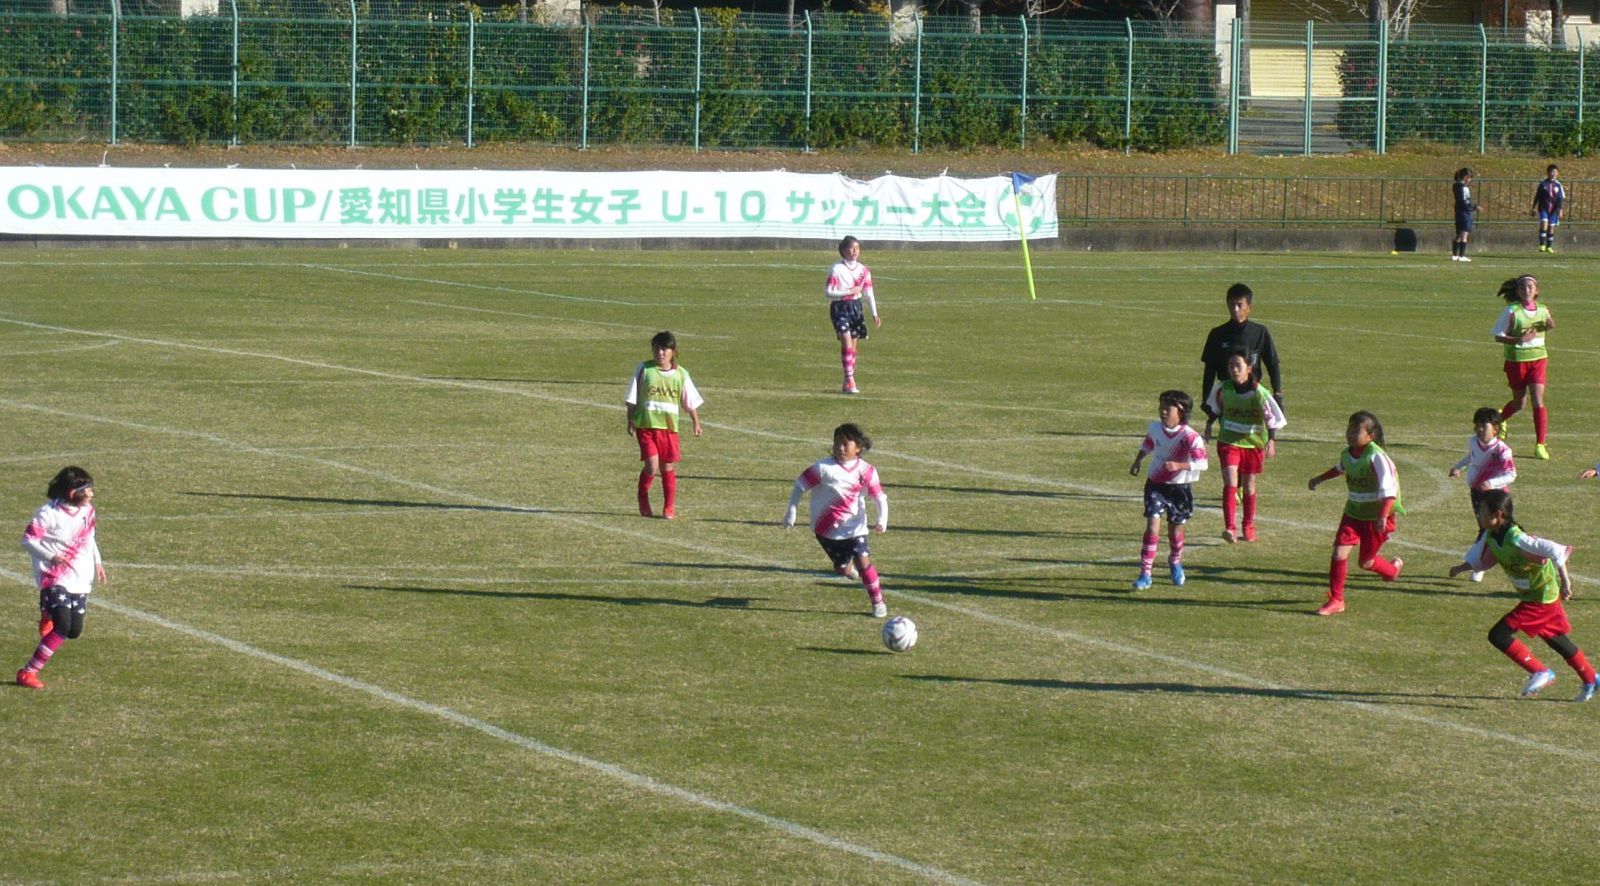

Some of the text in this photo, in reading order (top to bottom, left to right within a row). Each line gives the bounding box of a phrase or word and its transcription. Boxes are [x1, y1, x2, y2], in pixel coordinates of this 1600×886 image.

[7, 185, 189, 222] OKAYA
[663, 191, 765, 224] U-10
[786, 191, 986, 229] サッカー大会
